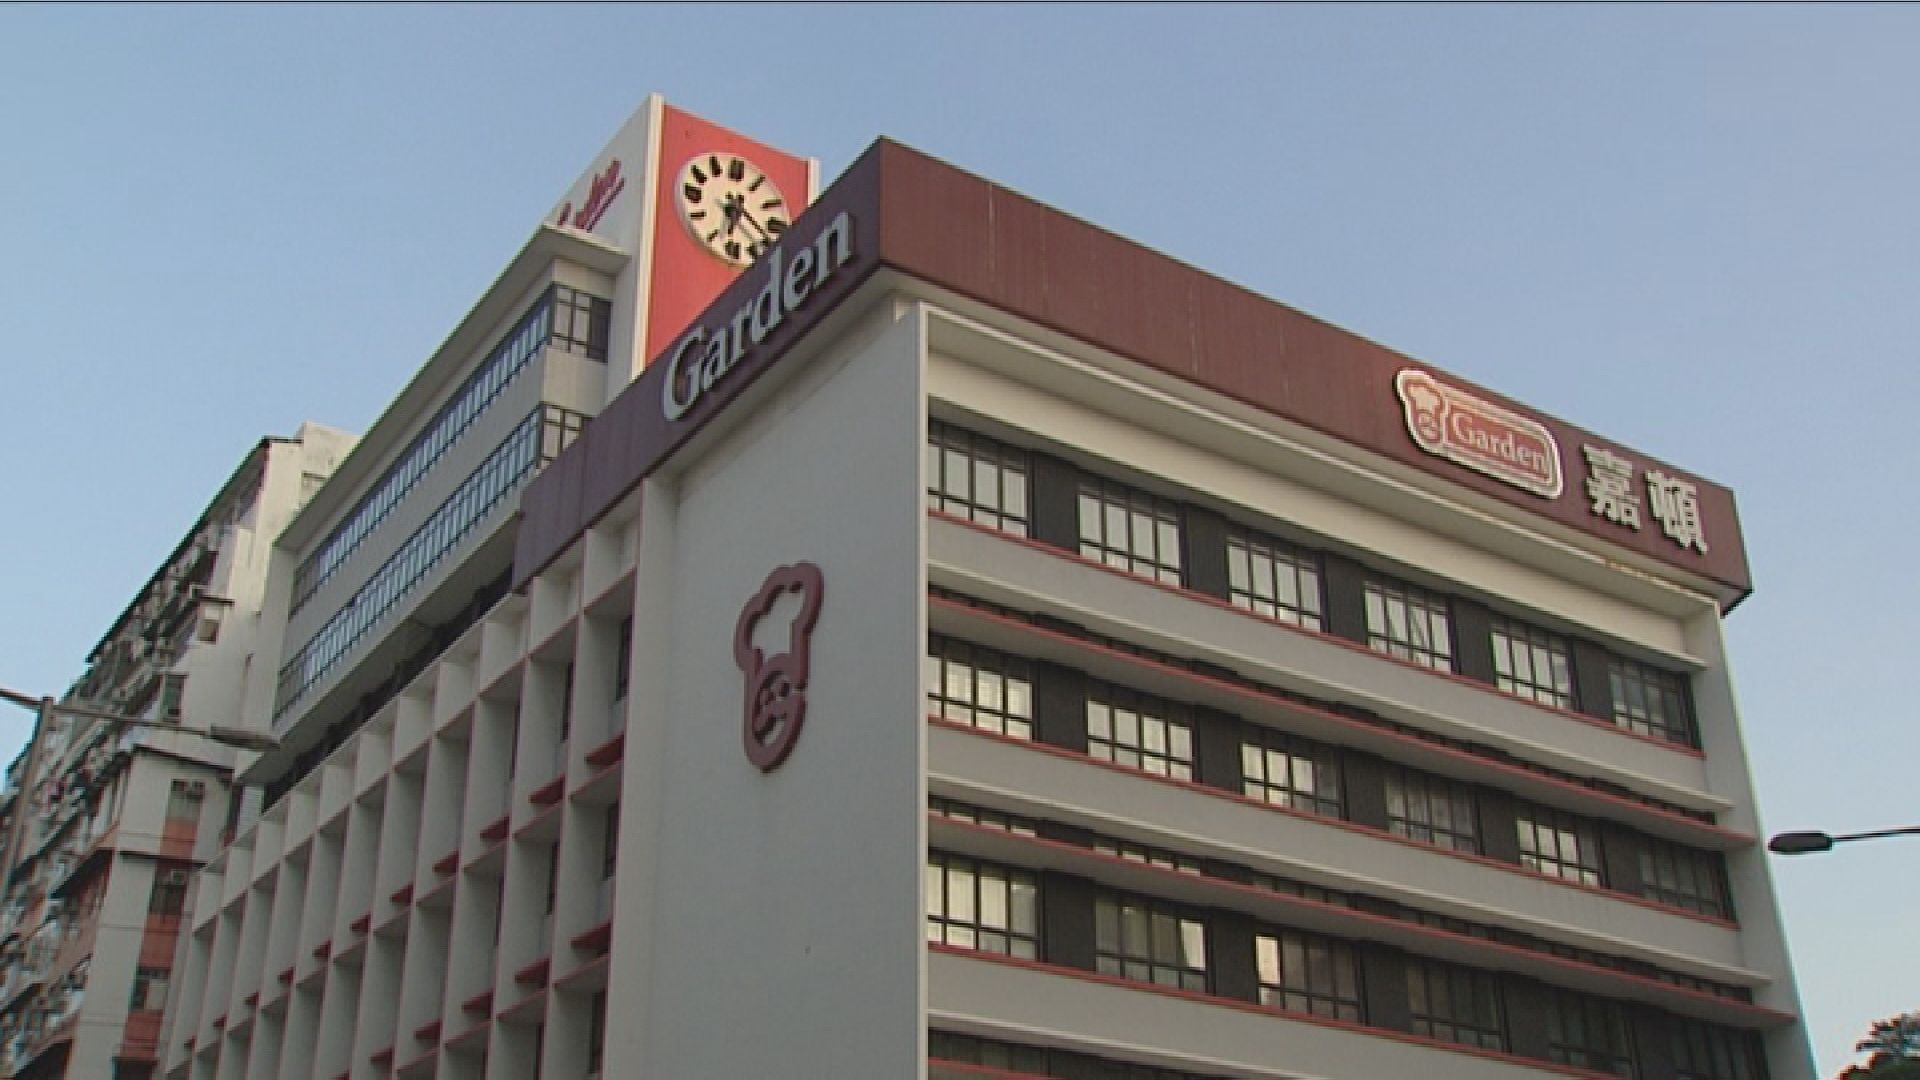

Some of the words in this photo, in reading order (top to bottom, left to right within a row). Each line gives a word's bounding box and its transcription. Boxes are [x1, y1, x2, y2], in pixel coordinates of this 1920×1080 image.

[662, 211, 853, 421] Garden
[1452, 412, 1549, 473] Garden
[1583, 443, 1707, 554] 嘉頓
